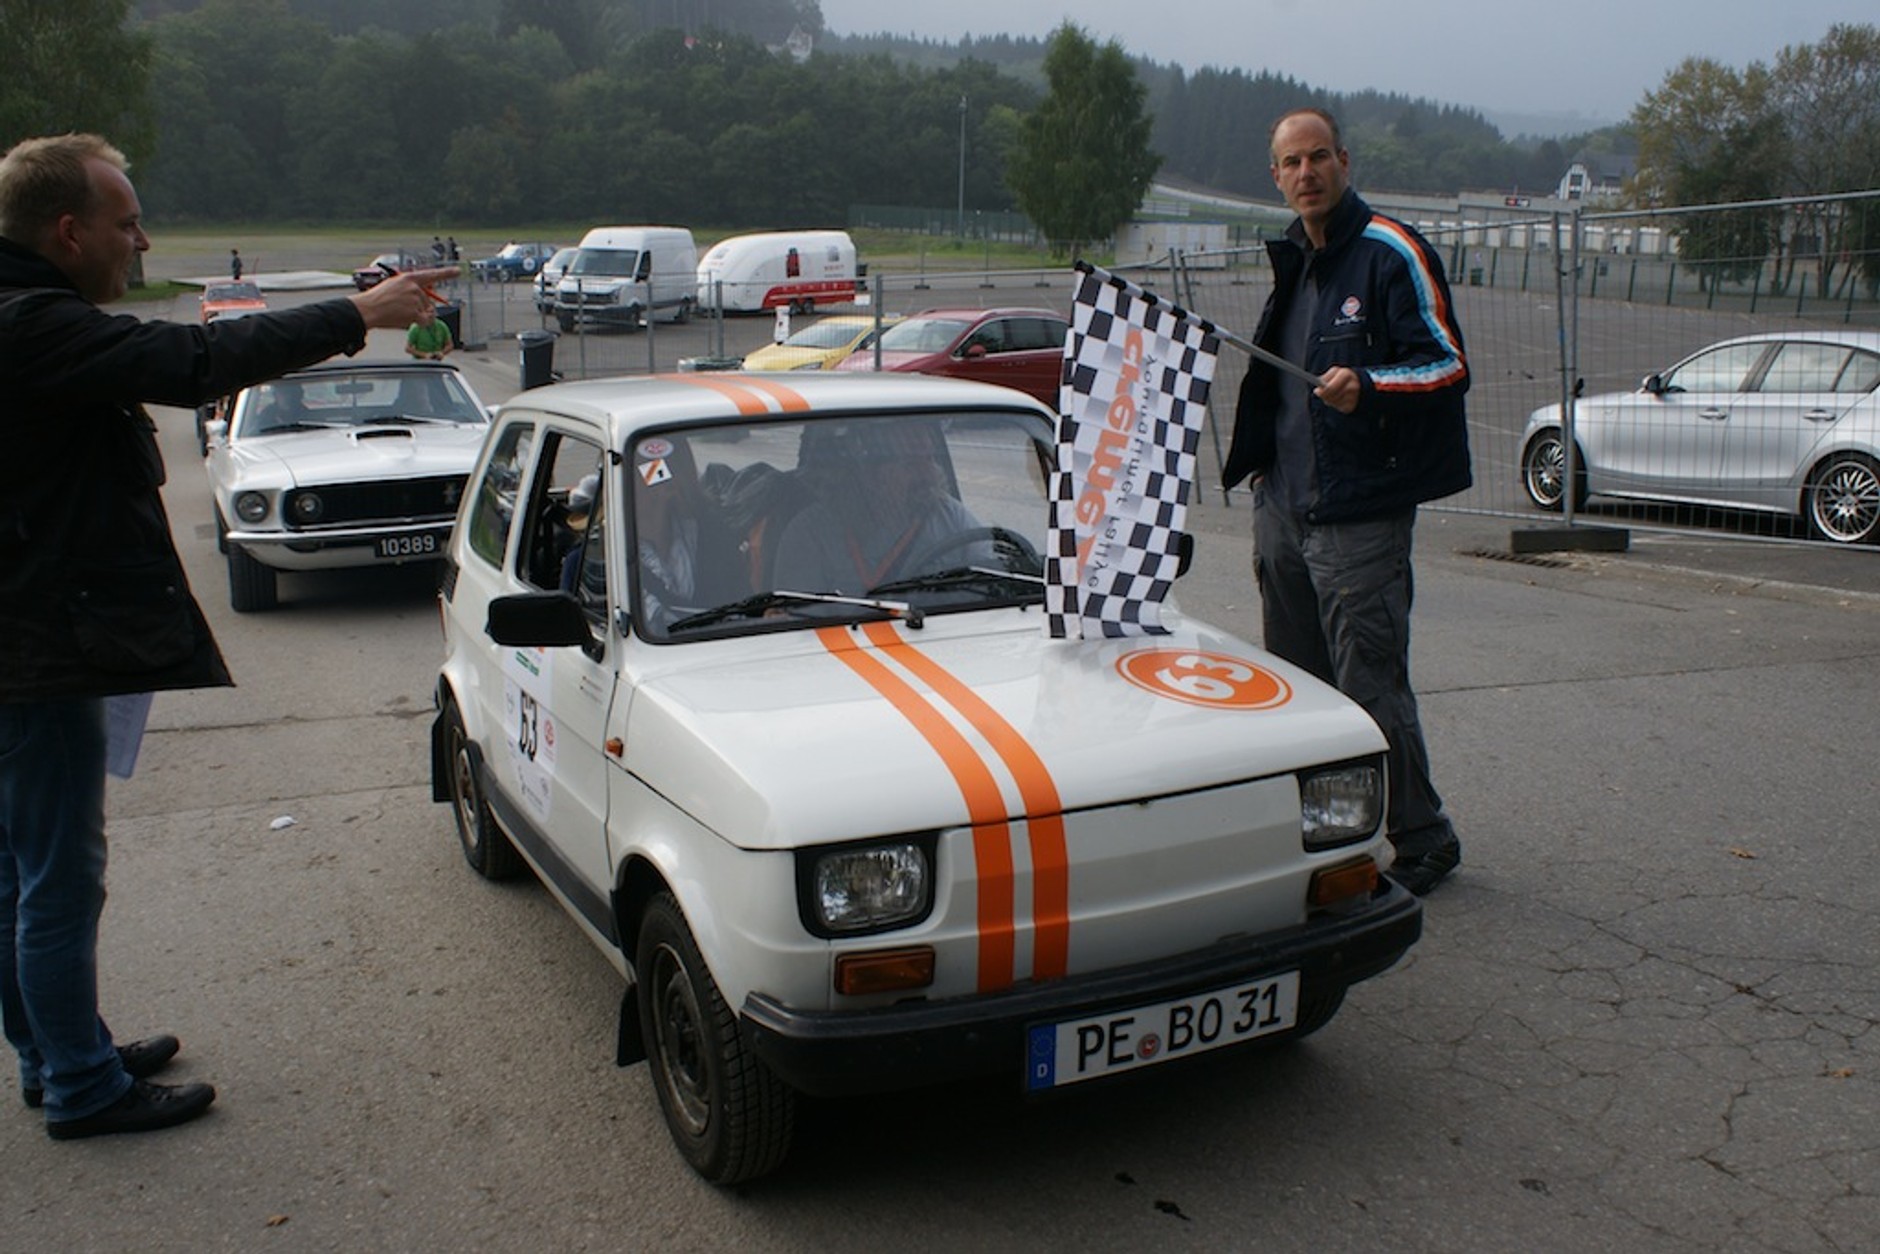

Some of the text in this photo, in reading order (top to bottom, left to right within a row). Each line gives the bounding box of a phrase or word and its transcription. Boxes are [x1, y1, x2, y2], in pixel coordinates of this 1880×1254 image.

[380, 535, 435, 556] 10389
[1155, 655, 1254, 699] 63
[1077, 982, 1282, 1072] PE BO 31
[1036, 1063, 1048, 1079] D
